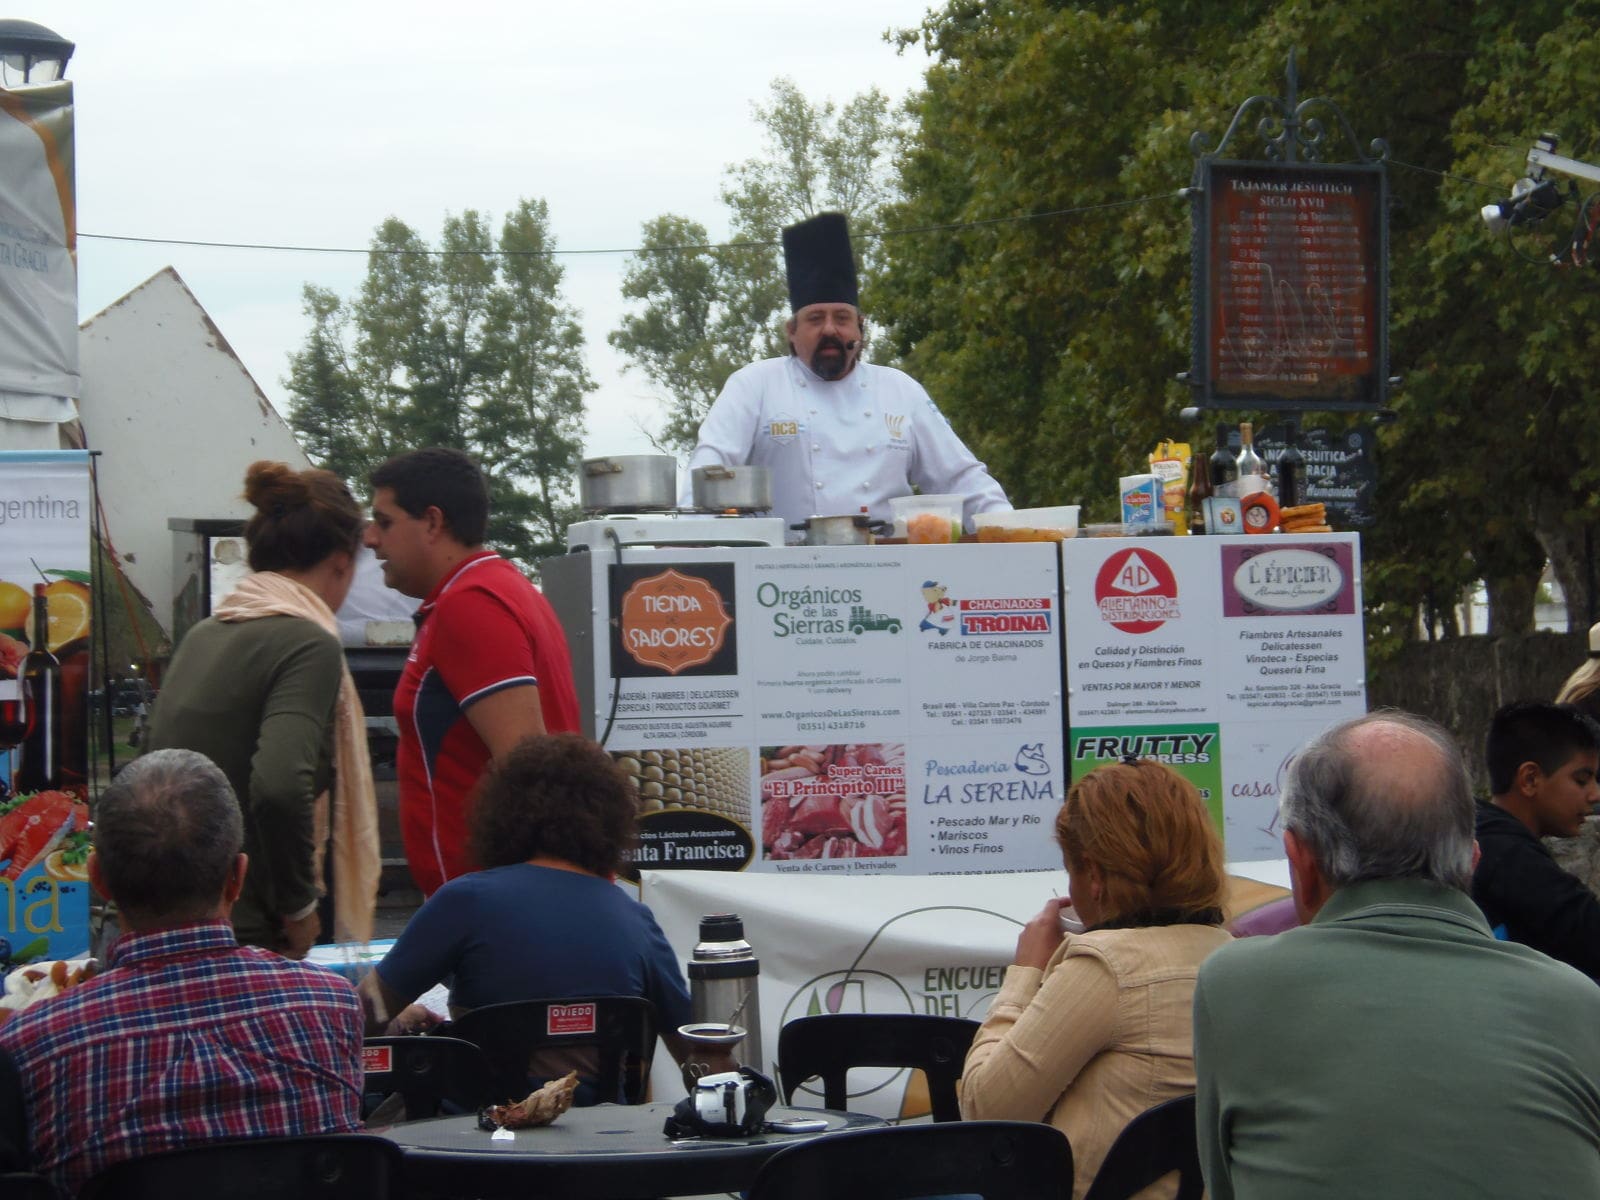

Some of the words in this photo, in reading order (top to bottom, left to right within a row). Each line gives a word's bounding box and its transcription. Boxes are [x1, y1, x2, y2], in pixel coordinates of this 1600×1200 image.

[1259, 196, 1297, 207] SIGLO
[1299, 197, 1325, 208] XVII
[1302, 450, 1346, 462] ESUITICA
[1306, 465, 1337, 476] RACIA
[756, 582, 862, 610] Orgánicos
[642, 595, 702, 613] TIENDA
[968, 599, 1043, 610] CHACINADOS
[1101, 596, 1167, 612] ALEMANNO
[802, 605, 817, 618] de
[822, 605, 838, 617] las
[773, 612, 845, 637] Sierras
[964, 614, 1048, 633] TROINA
[629, 626, 716, 648] SABORES
[1239, 631, 1284, 640] Fiambres
[1286, 629, 1343, 638] Artesanales
[928, 641, 967, 650] FABRICA
[969, 641, 981, 649] DE
[983, 640, 1044, 648] CHACINADOS
[1095, 646, 1130, 656] Calidad
[1131, 648, 1138, 657] y
[1139, 644, 1185, 655] Distinción
[1260, 641, 1322, 651] Delicatessen
[967, 654, 991, 664] Jorge
[1078, 661, 1090, 669] en
[1092, 660, 1125, 669] Quesos
[1126, 661, 1133, 670] y
[1134, 659, 1176, 667] Fiambres
[1177, 657, 1203, 667] Finos
[1245, 654, 1287, 663] Vinoteca
[1295, 653, 1339, 664] Especias
[1304, 664, 1326, 674] Fina
[1082, 683, 1113, 692] VENTAS
[1115, 682, 1132, 690] POR
[1133, 681, 1163, 690] MAYOR
[1164, 681, 1170, 689] Y
[1170, 680, 1201, 689] MENOR
[608, 691, 646, 701] PNADERÍA
[651, 690, 686, 700] FIAMBRES
[689, 689, 739, 699] DELICATESSEN
[616, 703, 651, 712] ESPECIAS
[655, 702, 697, 711] PRODUCTOS
[698, 701, 731, 710] GOURMET
[797, 722, 826, 731] (0351)
[827, 720, 866, 730] 4318716
[1075, 733, 1215, 760] FRUTTY
[828, 765, 862, 777] Super
[864, 763, 903, 776] Carnes
[793, 780, 873, 797] Principito
[923, 784, 952, 805] LA
[960, 779, 1054, 804] SERENA
[1232, 781, 1276, 797] casa
[937, 816, 986, 827] Pescado
[988, 815, 1009, 825] Mar
[1011, 817, 1019, 827] y
[690, 829, 736, 838] Artesanales
[937, 830, 988, 841] Mariscos
[621, 844, 659, 862] anta
[663, 839, 745, 861] Francisca
[938, 844, 970, 854] Vinos
[972, 843, 1004, 853] Finos
[776, 864, 801, 873] Venta
[802, 864, 813, 872] de
[815, 863, 845, 872] Carnes
[855, 861, 897, 870] Derivados
[552, 1007, 592, 1017] OVIEDO
